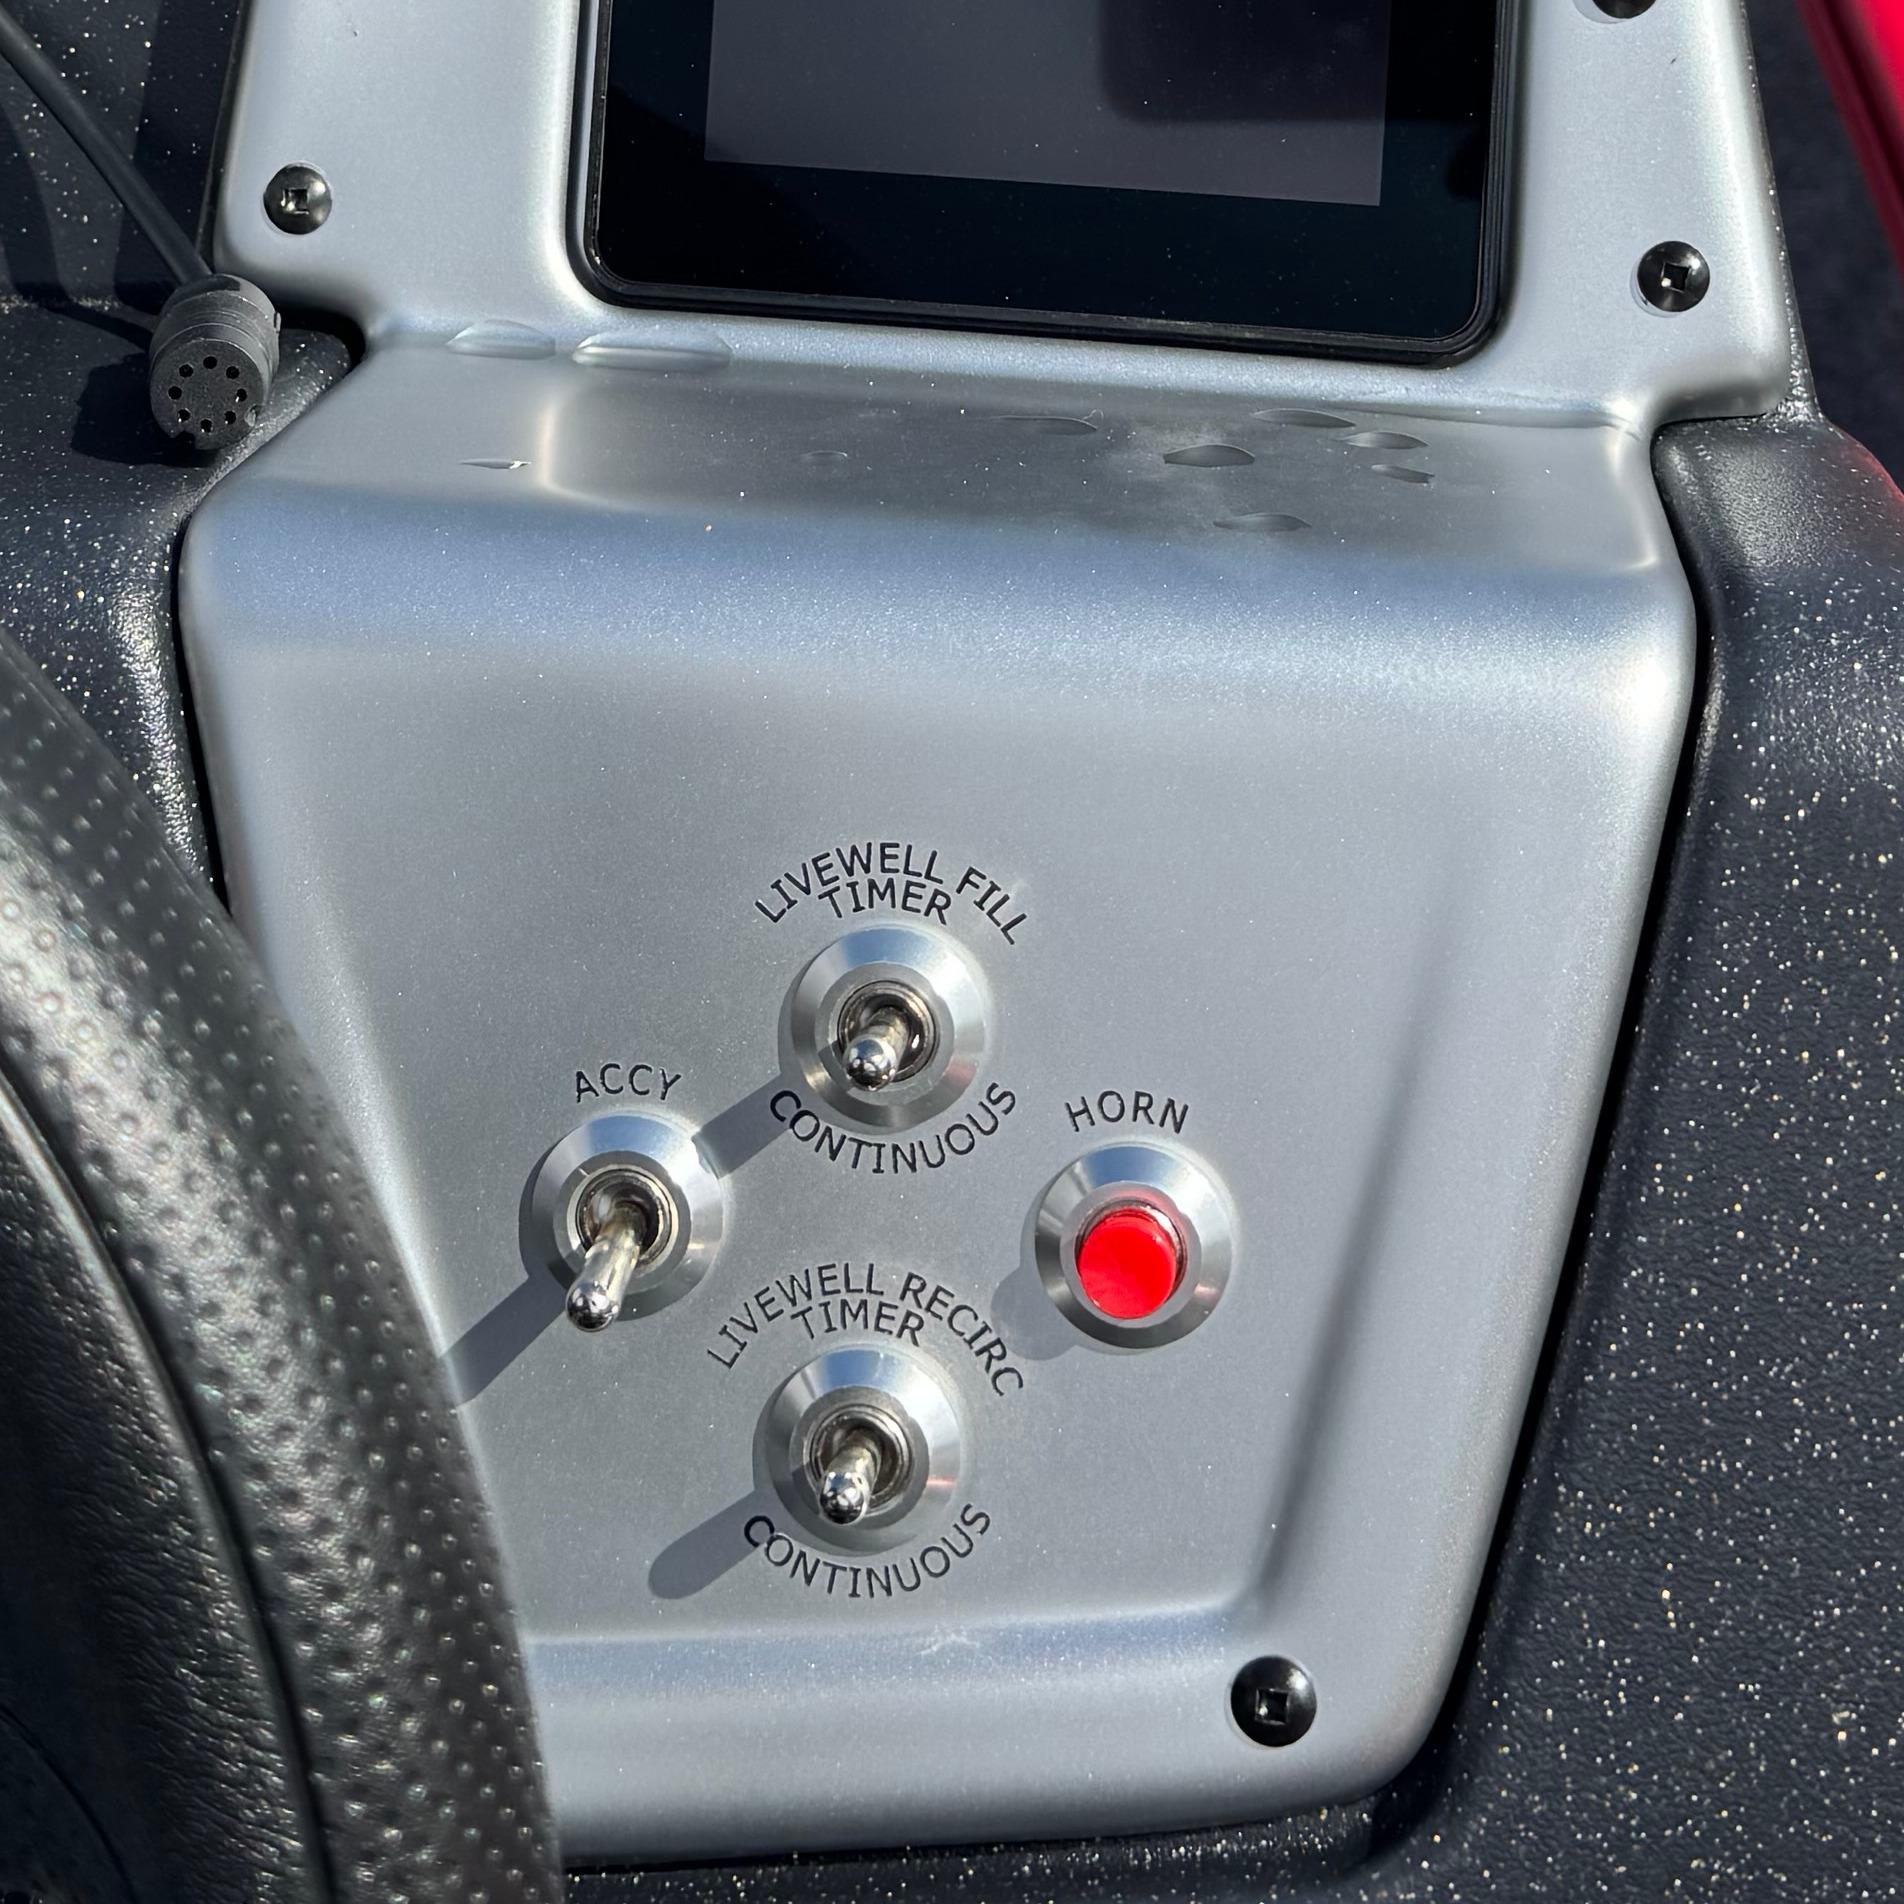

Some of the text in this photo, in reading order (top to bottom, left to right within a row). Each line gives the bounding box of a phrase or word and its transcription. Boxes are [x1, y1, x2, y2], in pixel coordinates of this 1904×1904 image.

[754, 841, 1027, 946] LIVEWELL FILL
[817, 877, 951, 925] TIMER
[576, 1062, 682, 1104] ACCY
[1064, 1090, 1189, 1135] HORN
[769, 1082, 1017, 1174] CONTINUOUS
[707, 1262, 1024, 1397] LIVEWELL RECIRC
[790, 1298, 925, 1347] TIMER
[743, 1503, 991, 1598] CONTINUOUS
